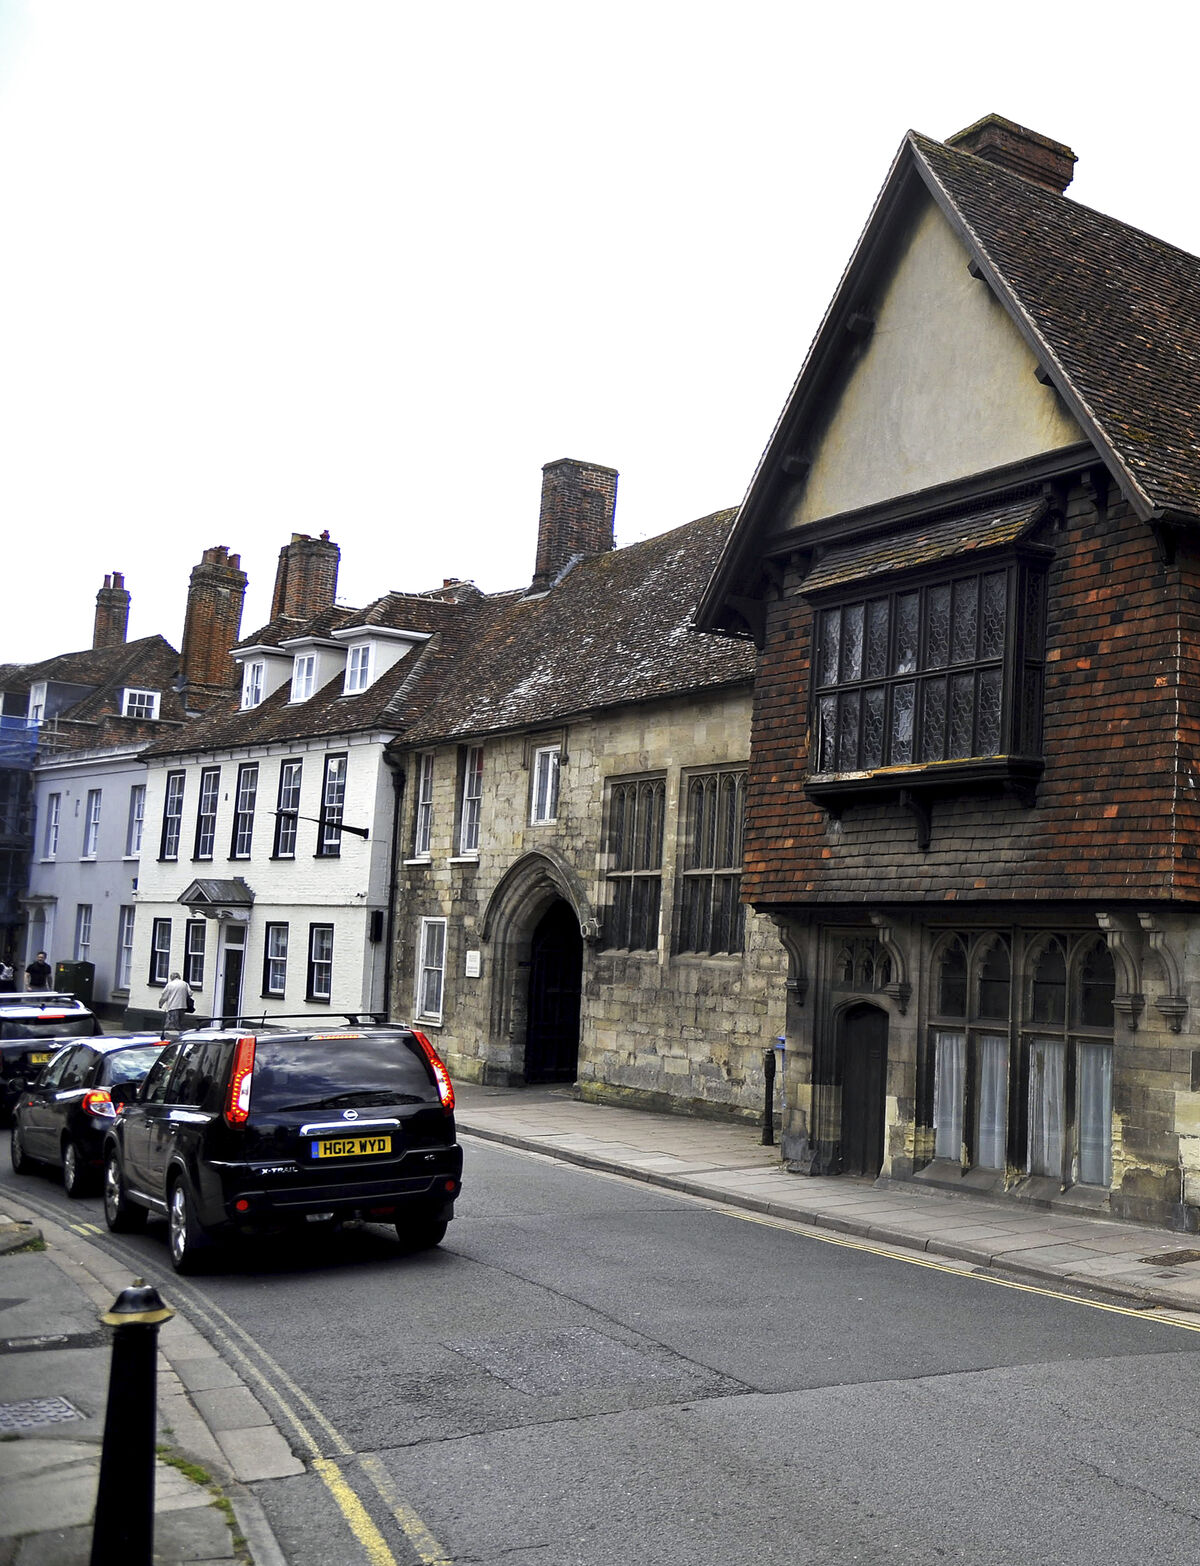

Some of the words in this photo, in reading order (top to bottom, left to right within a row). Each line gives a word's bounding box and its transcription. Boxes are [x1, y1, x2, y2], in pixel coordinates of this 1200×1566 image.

[323, 1141, 355, 1156] HG12
[359, 1139, 386, 1153] WYD
[261, 1167, 298, 1175] X-TRAIL
